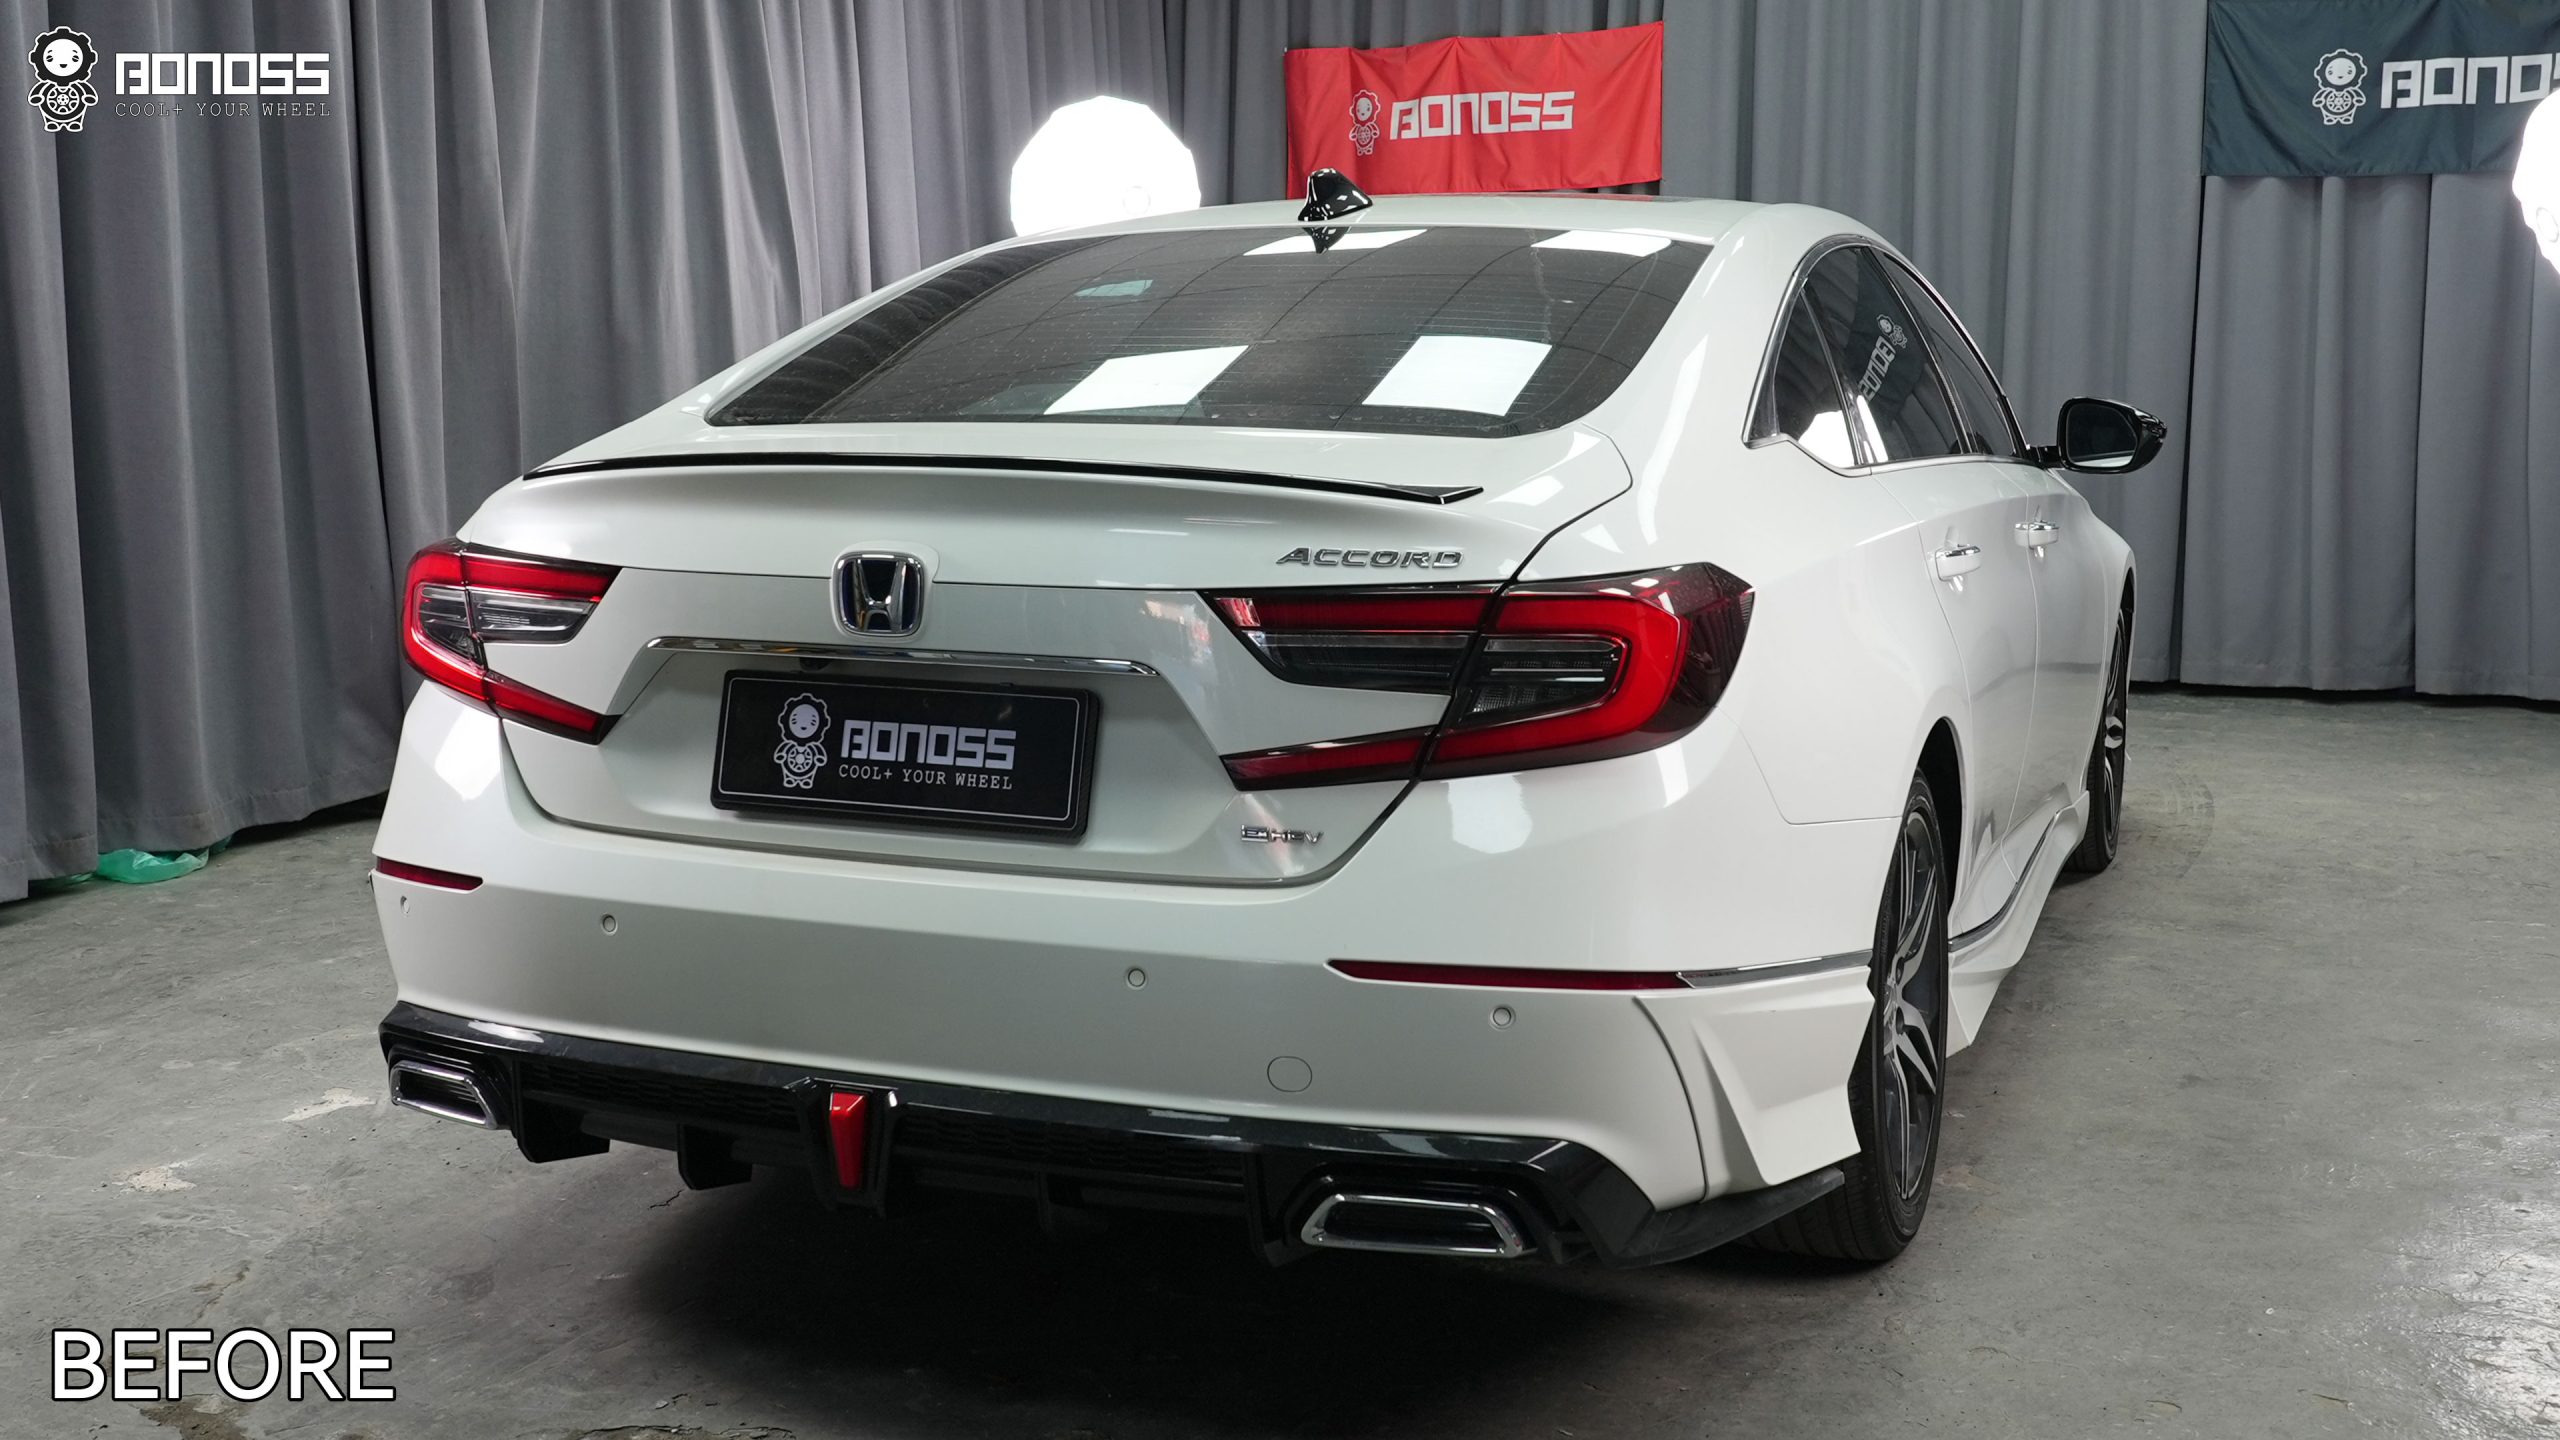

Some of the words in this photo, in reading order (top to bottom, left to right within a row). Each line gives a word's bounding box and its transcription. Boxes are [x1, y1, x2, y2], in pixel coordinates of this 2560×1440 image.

[2381, 53, 2560, 109] BONO
[1390, 91, 1575, 140] BONOSS
[1276, 546, 1464, 569] ACCORD
[840, 719, 1017, 770] BONOSS
[838, 764, 893, 780] COOL+
[902, 768, 947, 785] YOUR
[955, 772, 1013, 790] WHEEL
